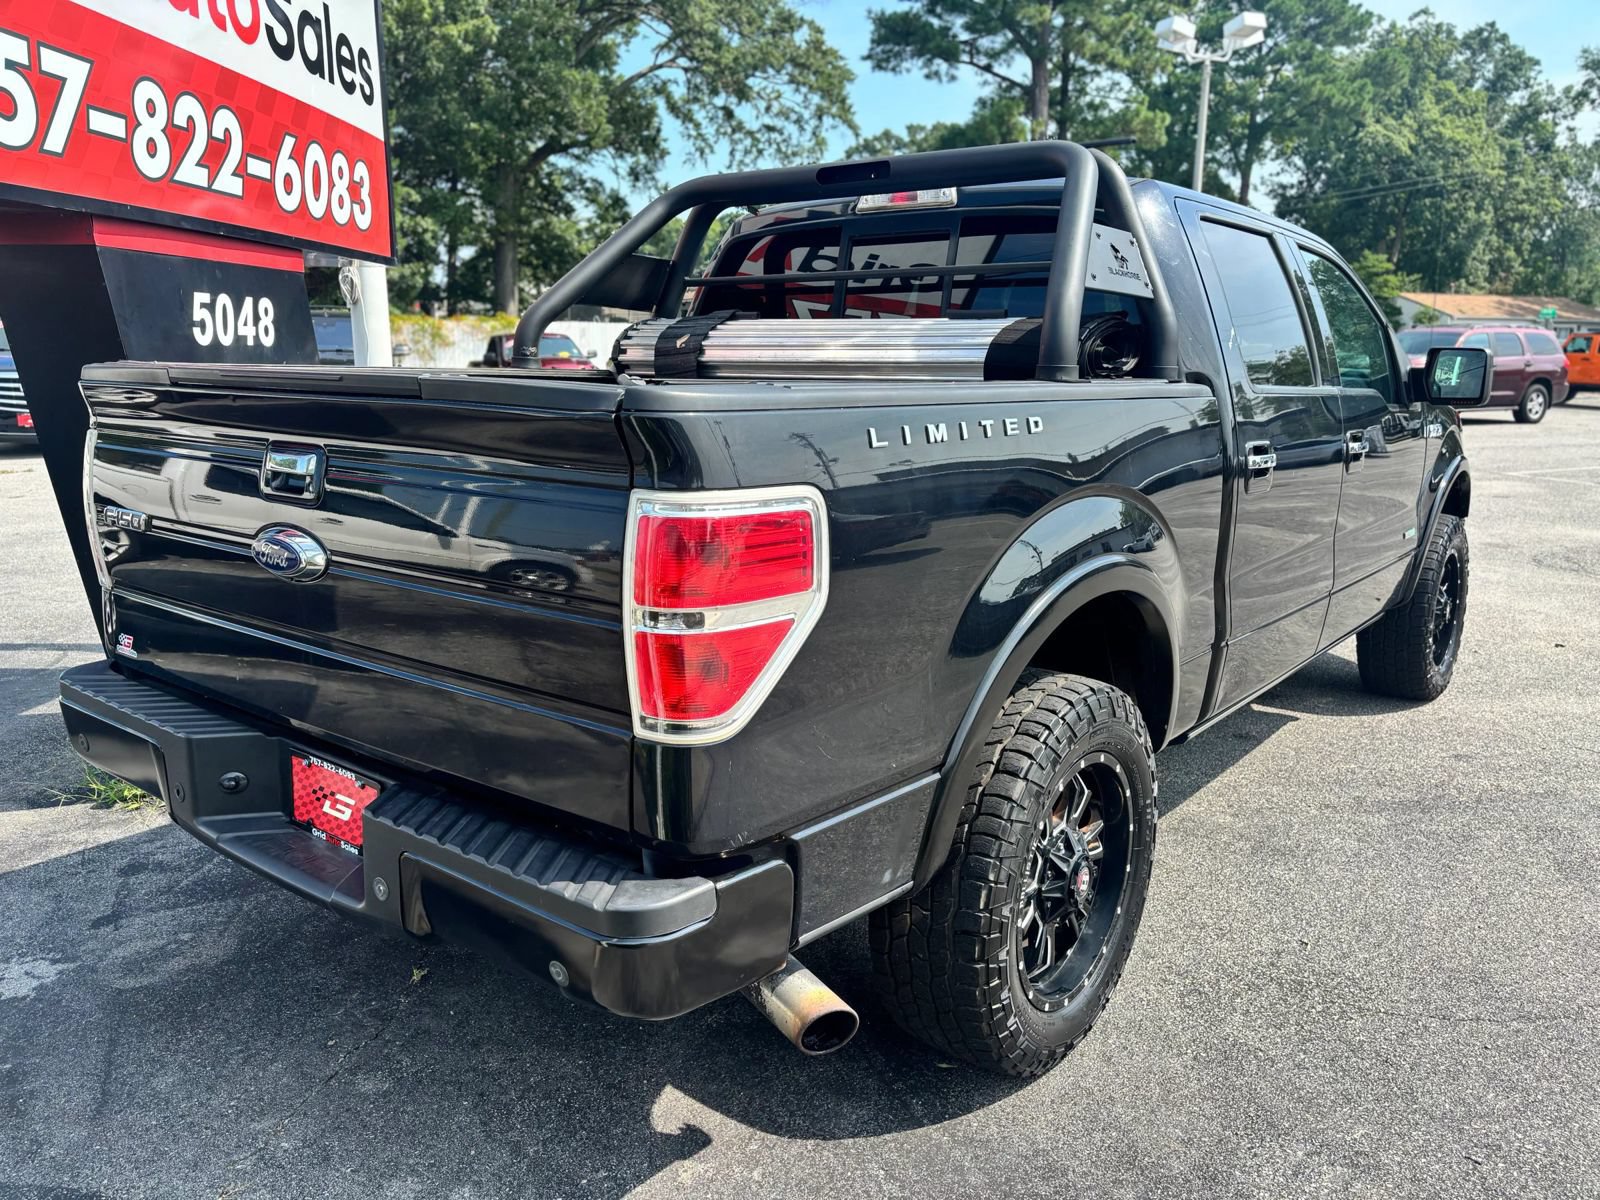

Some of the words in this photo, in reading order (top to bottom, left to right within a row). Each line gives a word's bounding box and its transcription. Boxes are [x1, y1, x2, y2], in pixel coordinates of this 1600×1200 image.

[192, 290, 275, 347] 5048
[867, 416, 1044, 449] LIMITED
[260, 540, 289, 568] Ford
